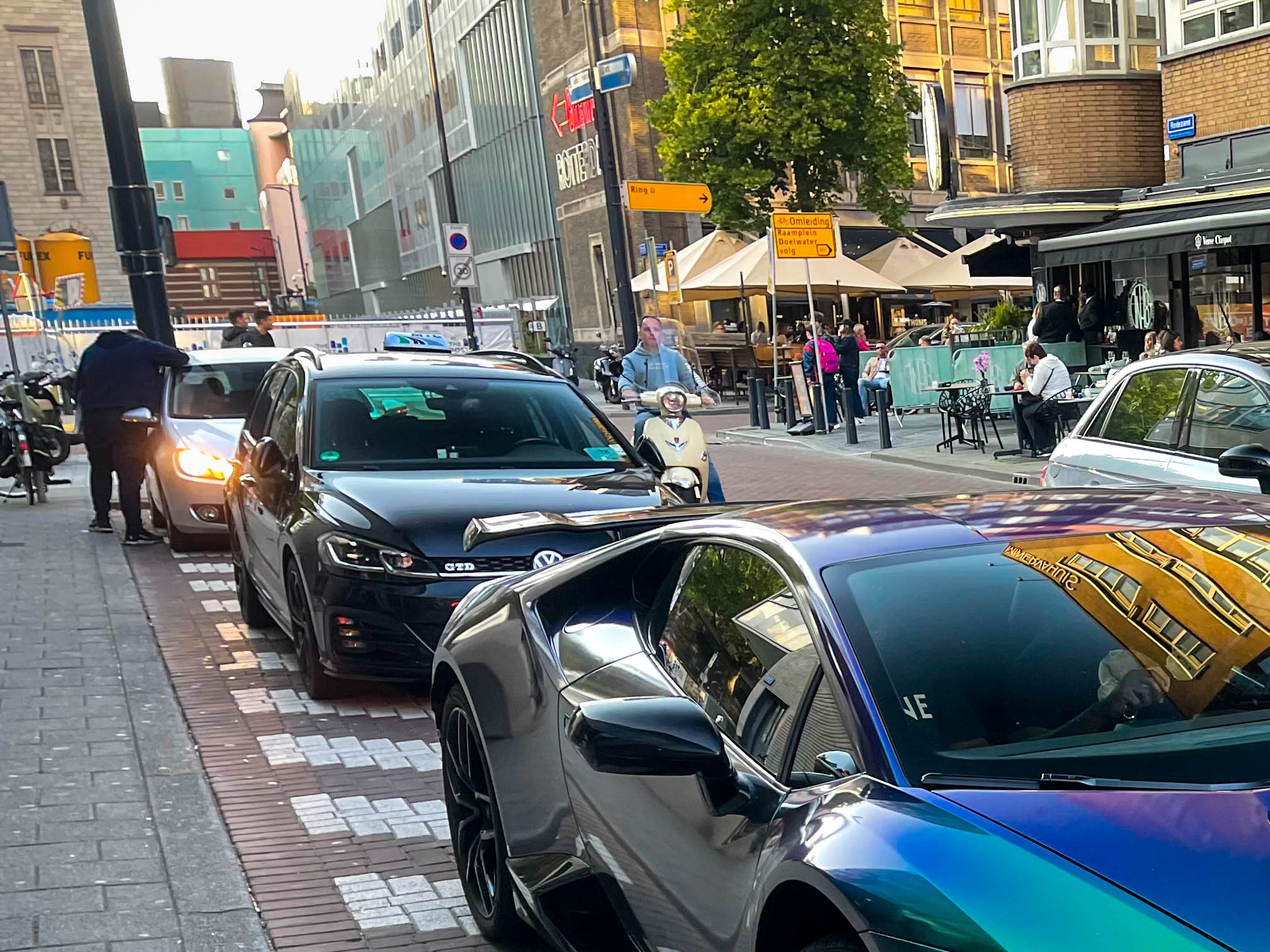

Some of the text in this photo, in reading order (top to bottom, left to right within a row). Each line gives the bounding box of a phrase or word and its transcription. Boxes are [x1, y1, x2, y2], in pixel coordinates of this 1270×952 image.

[630, 186, 648, 194] Ring
[789, 217, 829, 228] Omleiding
[444, 562, 475, 571] GTD
